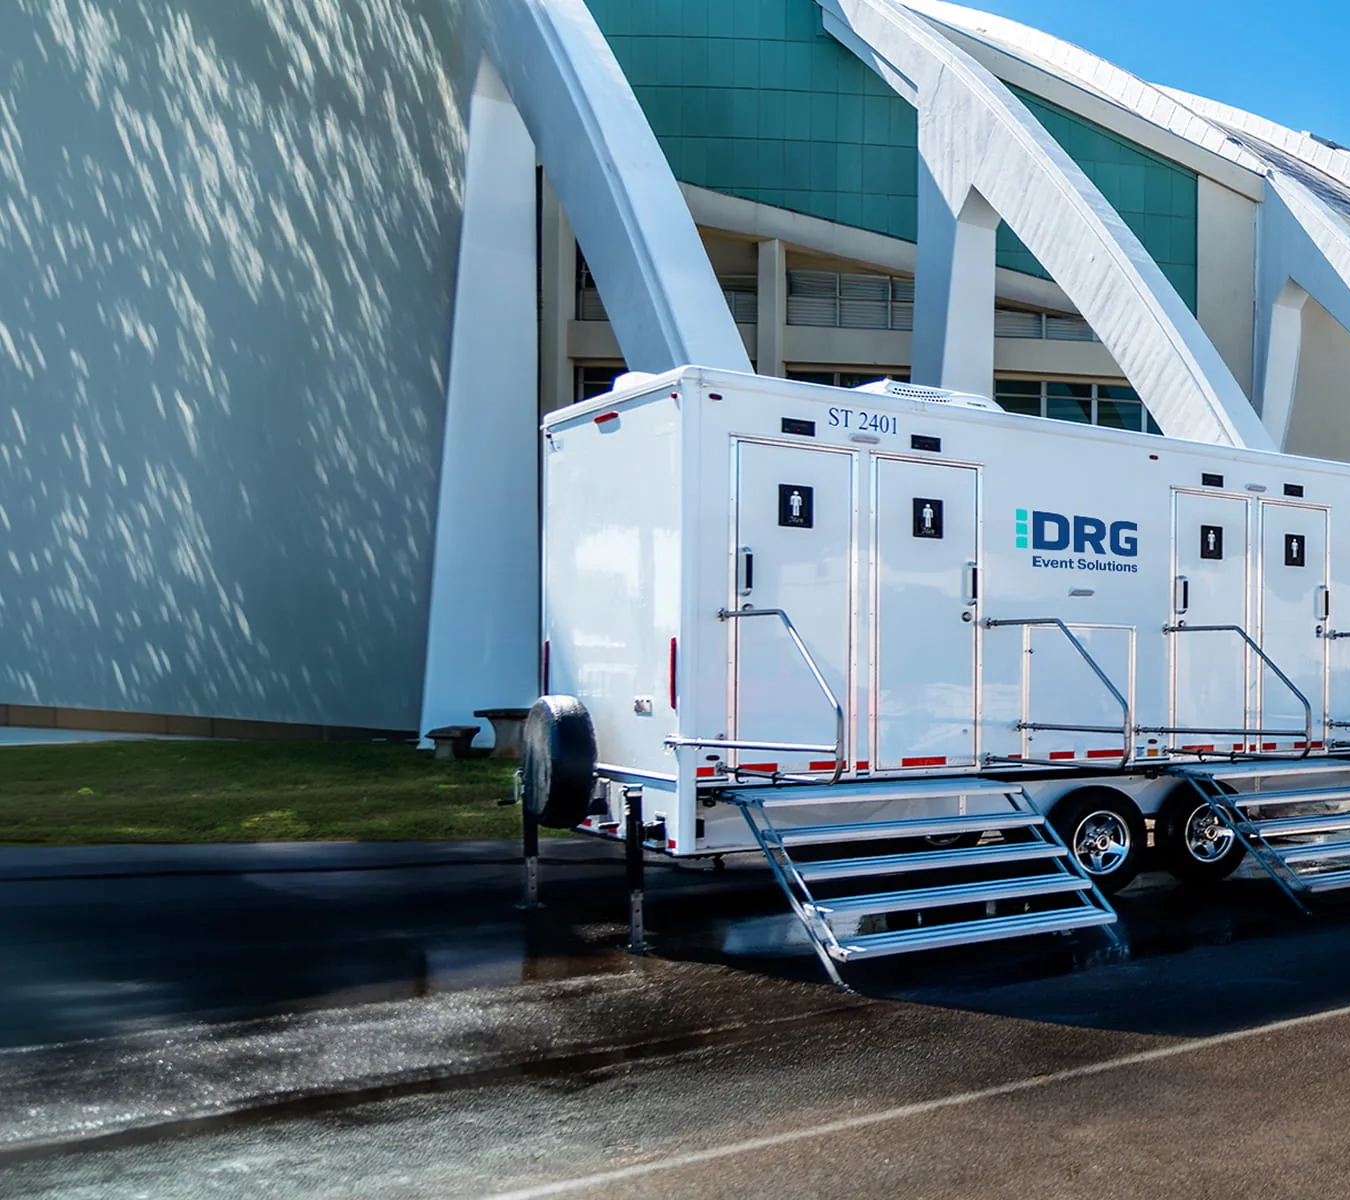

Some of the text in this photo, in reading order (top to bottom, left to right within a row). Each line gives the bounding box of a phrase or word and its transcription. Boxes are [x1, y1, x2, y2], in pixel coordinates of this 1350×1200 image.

[828, 407, 897, 435] ST 2401
[1032, 510, 1138, 557] DRG
[1032, 555, 1138, 573] Event Solutions
